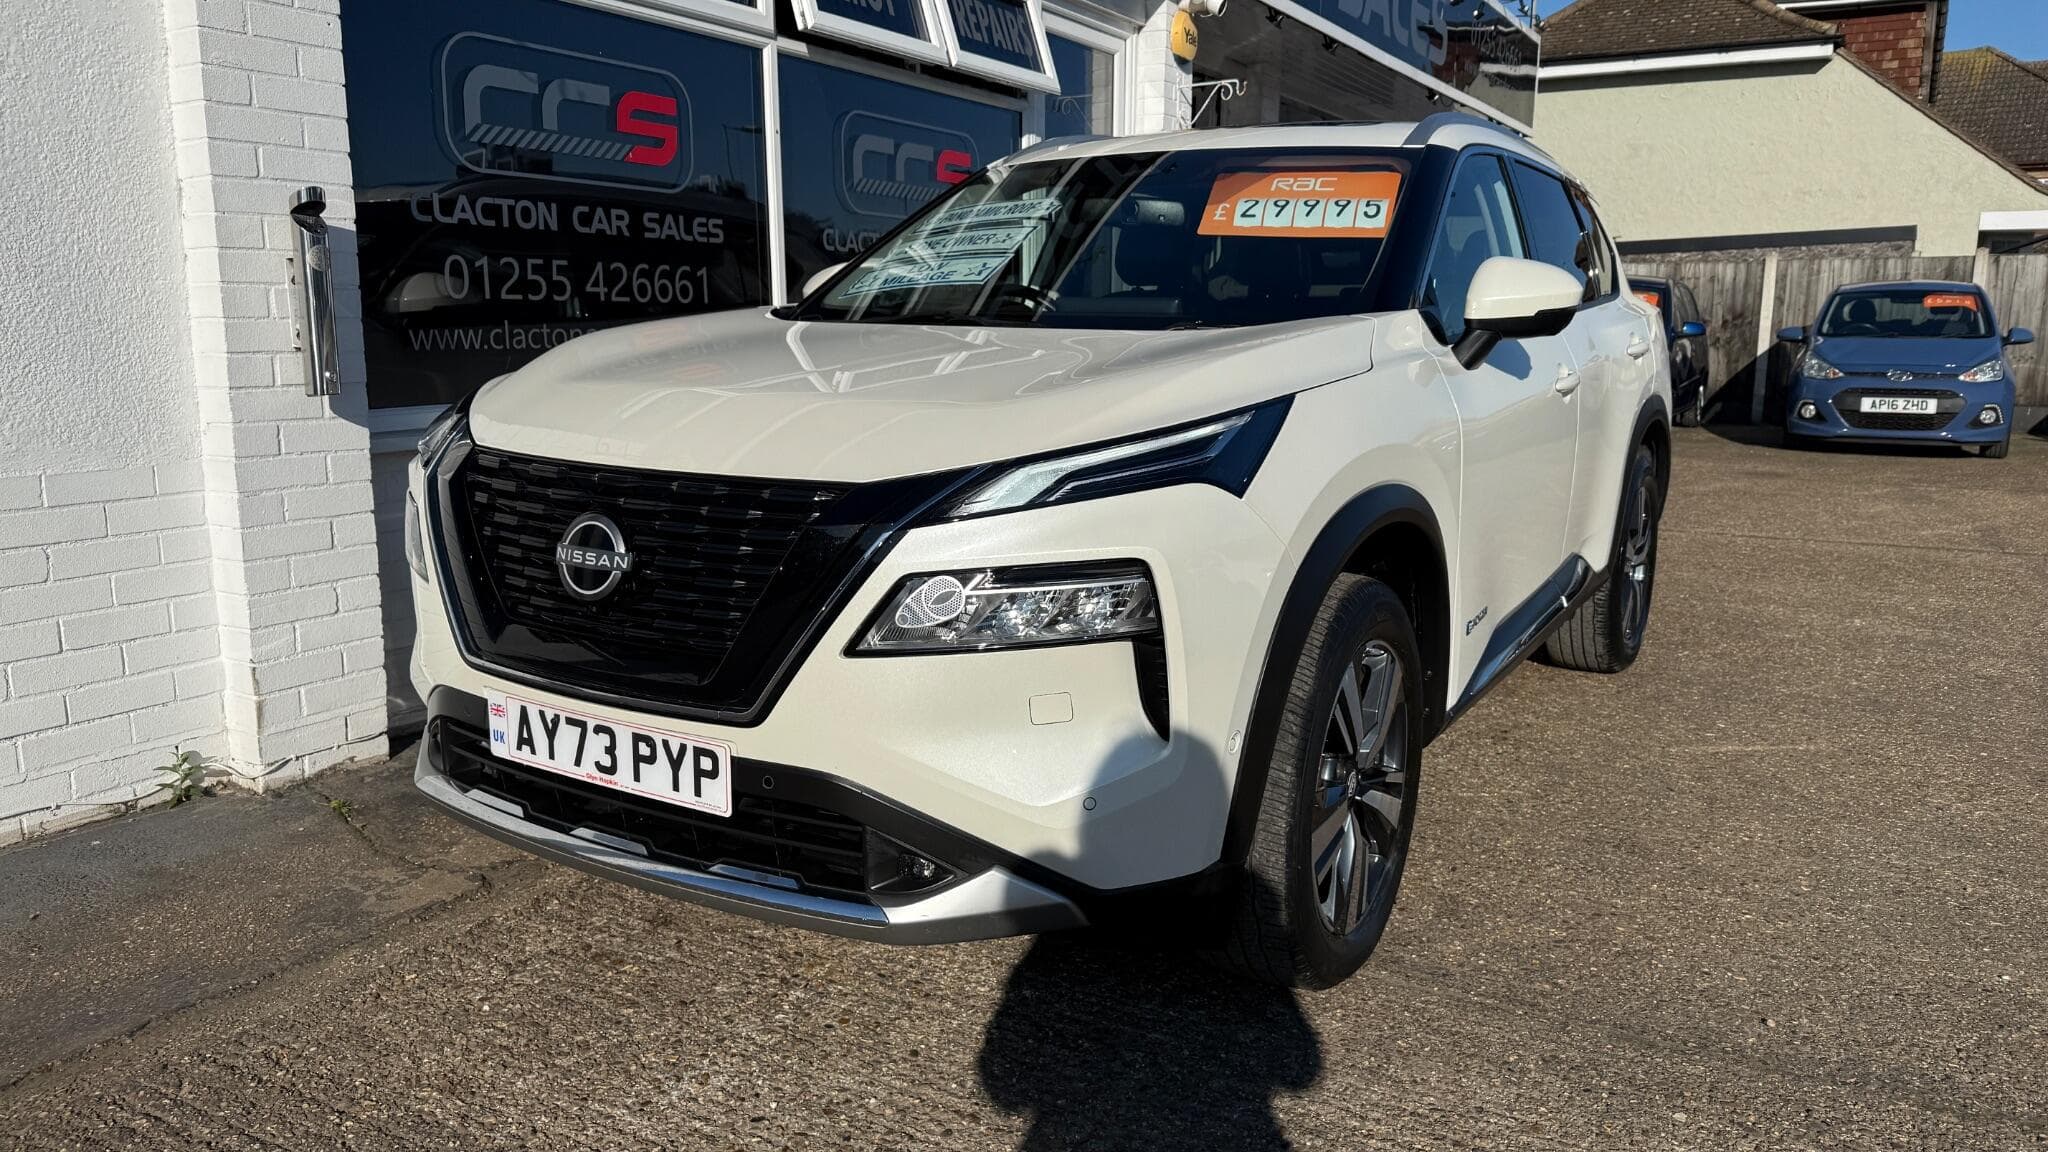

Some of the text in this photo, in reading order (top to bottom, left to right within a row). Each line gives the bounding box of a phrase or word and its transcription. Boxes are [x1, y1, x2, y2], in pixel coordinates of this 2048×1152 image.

[953, 0, 1035, 57] REPAIRS
[411, 192, 724, 243] CLACTON CAR SALES
[1240, 199, 1382, 219] 29995
[443, 254, 709, 304] 01255 426661
[880, 270, 958, 286] MILEAGE
[1871, 399, 1899, 410] AP16
[557, 546, 628, 569] NISSAN
[492, 729, 506, 744] UK
[516, 704, 720, 798] AY73 PYP
